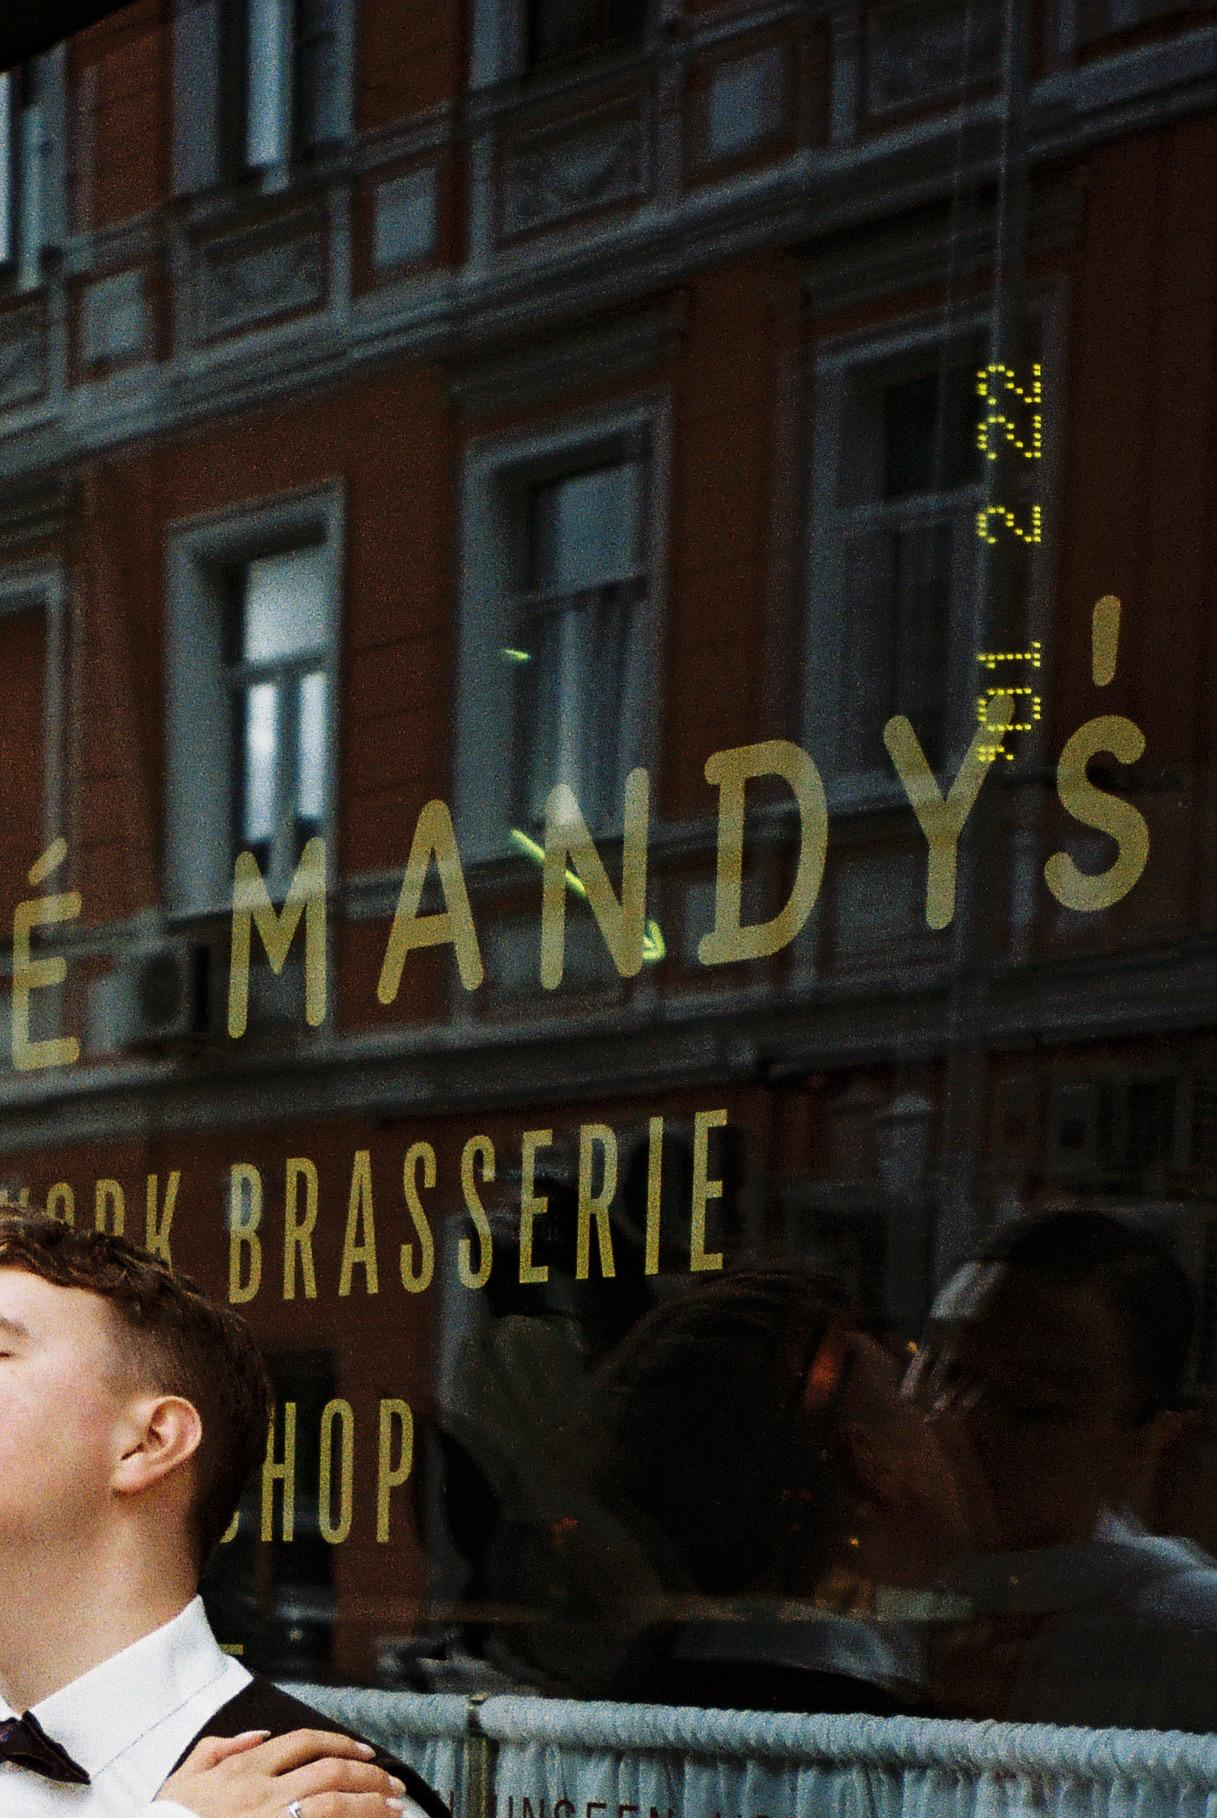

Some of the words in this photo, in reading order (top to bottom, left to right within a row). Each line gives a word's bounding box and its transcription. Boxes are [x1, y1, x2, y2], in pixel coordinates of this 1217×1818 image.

[228, 595, 1150, 1039] MANDY'S
[228, 1108, 726, 1304] BRASSERIE
[220, 1398, 414, 1545] HOP
